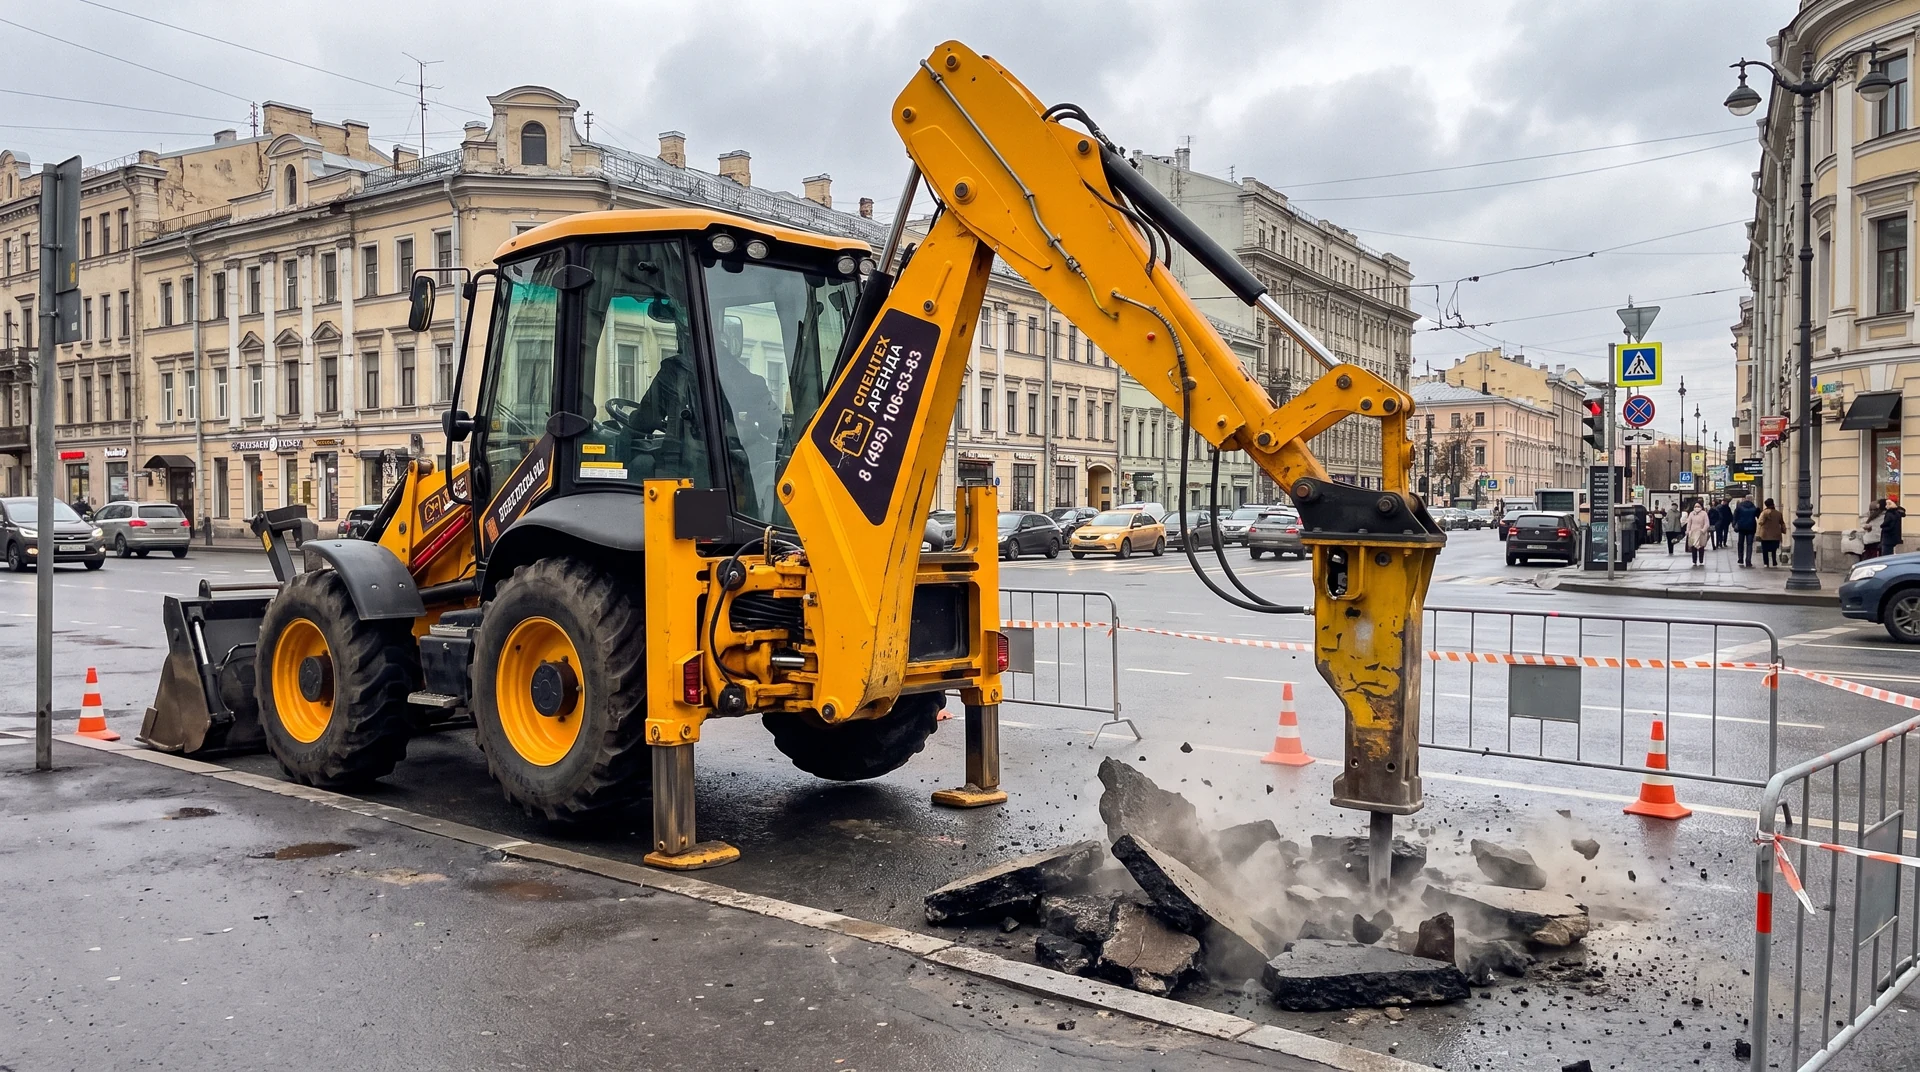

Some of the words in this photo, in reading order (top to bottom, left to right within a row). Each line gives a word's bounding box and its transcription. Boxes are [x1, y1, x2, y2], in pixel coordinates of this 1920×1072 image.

[853, 335, 891, 407] СПЕЦТЕХ
[867, 344, 903, 413] АРЕНДА
[883, 350, 922, 422] 106-63-83
[858, 469, 872, 482] 8
[864, 426, 893, 468] (495)
